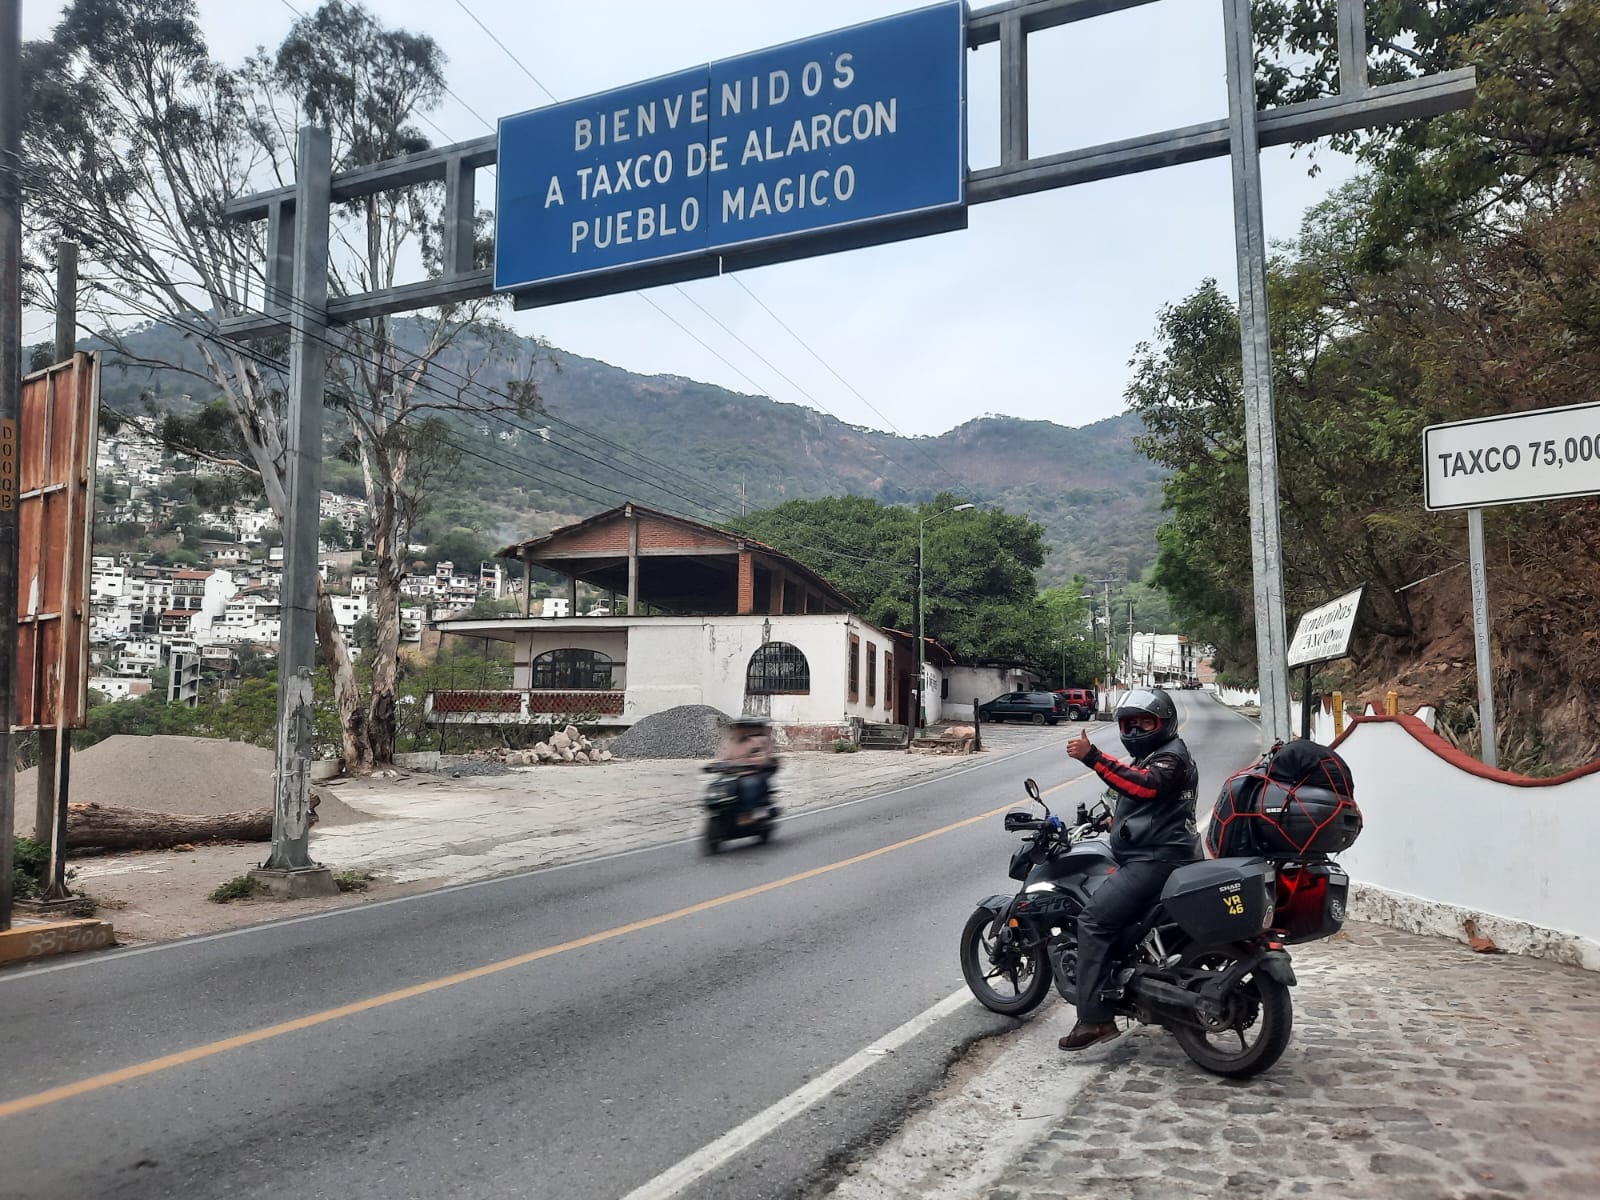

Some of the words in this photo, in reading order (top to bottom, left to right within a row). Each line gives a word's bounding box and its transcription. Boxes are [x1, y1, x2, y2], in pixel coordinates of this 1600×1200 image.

[574, 53, 855, 152] BIENVENIDOS
[544, 176, 565, 208] A
[576, 151, 673, 201] TAXCO
[686, 137, 728, 178] DE
[741, 98, 897, 166] ALARCON
[571, 197, 699, 254] PUEBLO
[722, 165, 855, 224] MAGICO
[1438, 445, 1521, 478] TAXCO
[1223, 894, 1242, 907] VR
[1229, 904, 1244, 915] 46
